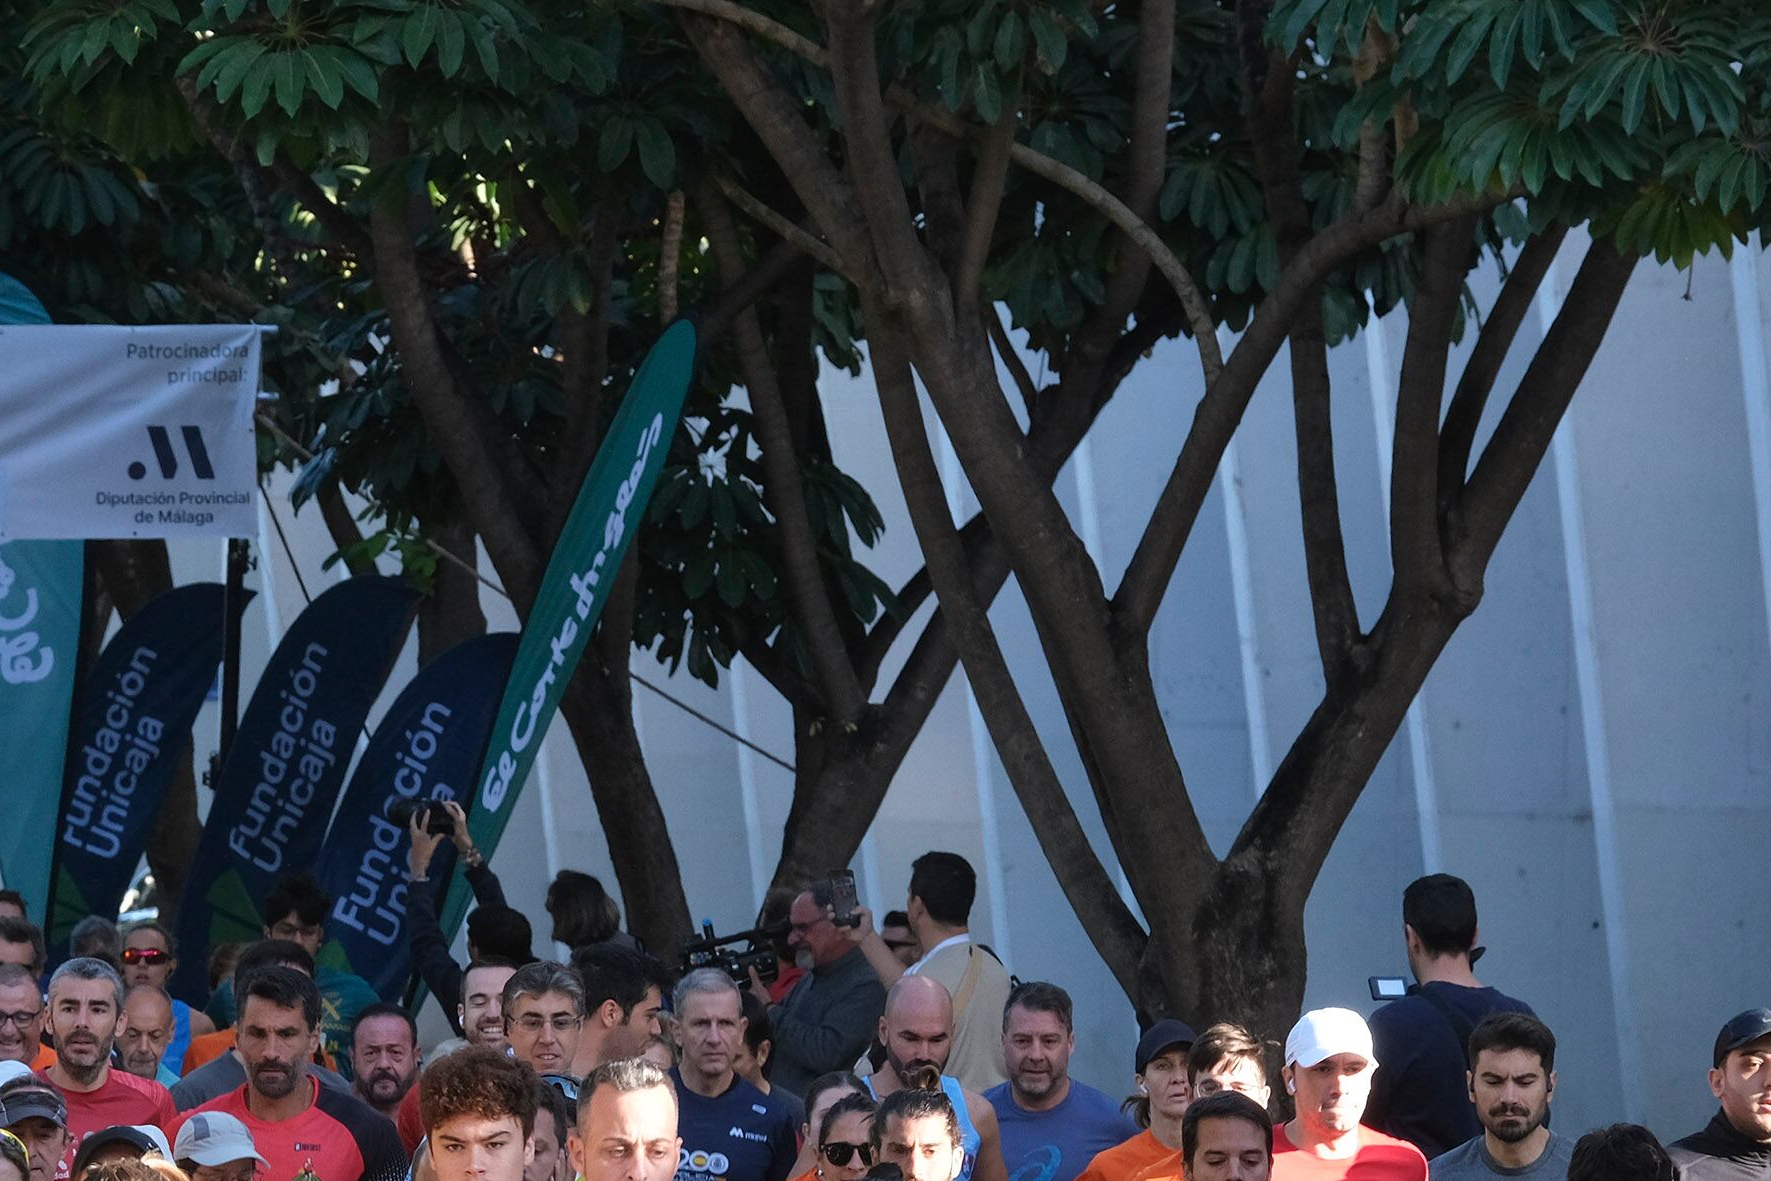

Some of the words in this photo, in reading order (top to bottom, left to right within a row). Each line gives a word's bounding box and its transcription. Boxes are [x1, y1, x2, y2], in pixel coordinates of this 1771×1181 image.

[126, 343, 249, 359] Patrocinadora
[167, 367, 248, 385] principal:
[96, 491, 176, 508] Diputación
[178, 491, 251, 505] Provincial
[134, 510, 151, 524] de
[158, 509, 214, 525] Málaga
[228, 641, 328, 861] Fundación
[85, 715, 164, 859] Unicaja
[252, 717, 337, 873] Unicaja
